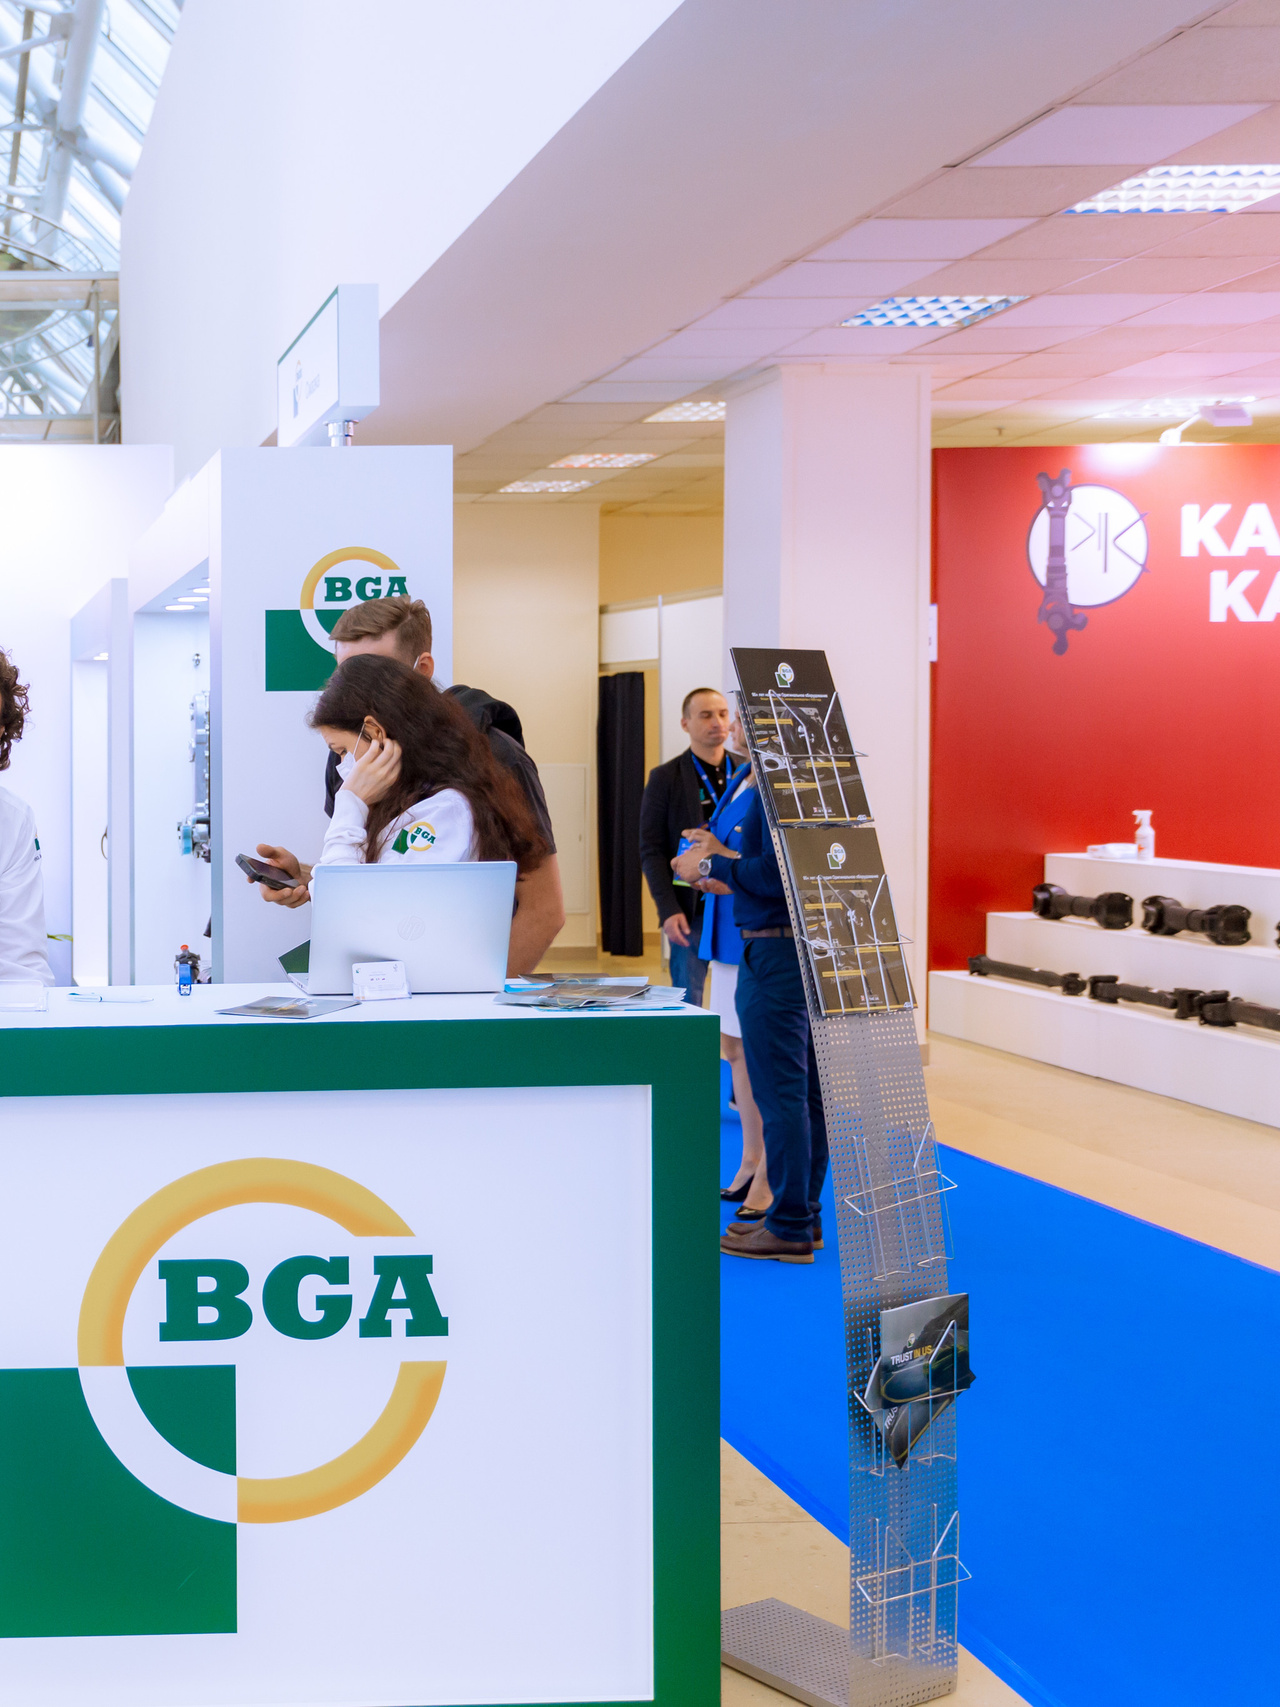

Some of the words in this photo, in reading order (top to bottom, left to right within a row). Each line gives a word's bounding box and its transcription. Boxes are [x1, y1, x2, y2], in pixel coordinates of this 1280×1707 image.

[324, 576, 409, 602] BGA
[414, 826, 436, 844] BGA
[158, 1254, 449, 1342] BGA
[890, 1350, 914, 1366] TRUST
[913, 1349, 922, 1359] IN
[921, 1345, 933, 1356] US
